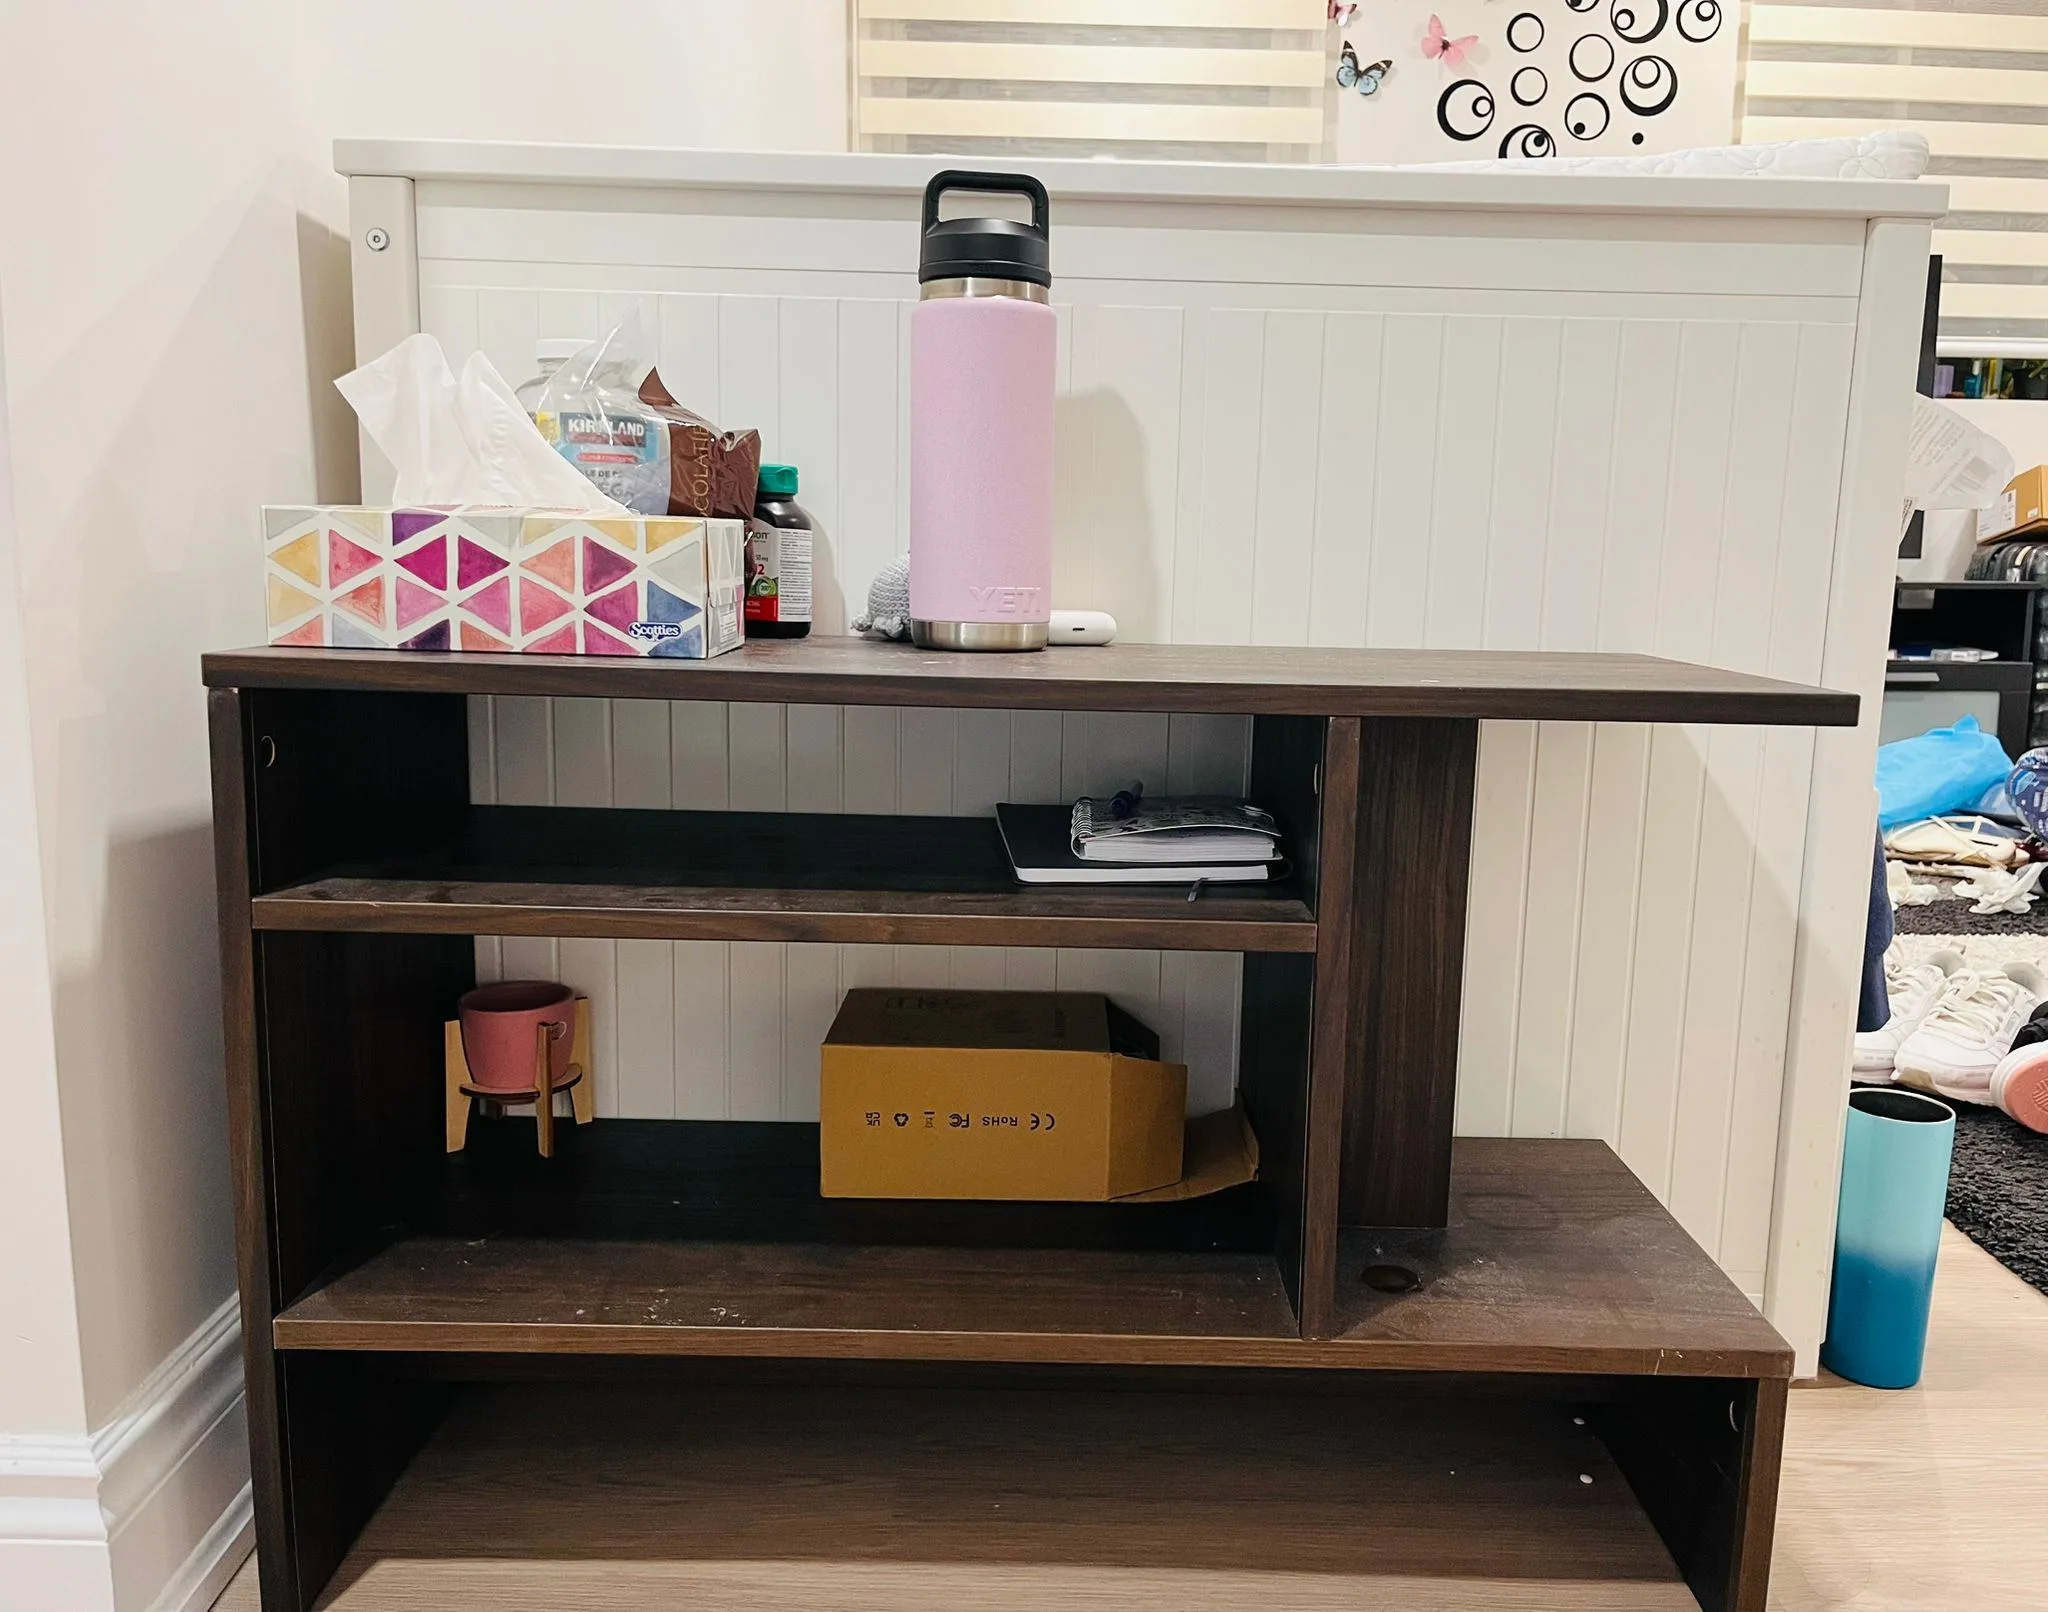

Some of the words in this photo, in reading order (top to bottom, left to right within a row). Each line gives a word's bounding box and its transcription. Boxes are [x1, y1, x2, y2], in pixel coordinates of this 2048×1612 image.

[757, 564, 765, 575] 2
[968, 586, 1040, 613] YETI
[630, 623, 679, 640] Scotties
[982, 1116, 1018, 1127] RoHS
[1030, 1113, 1055, 1131] CE
